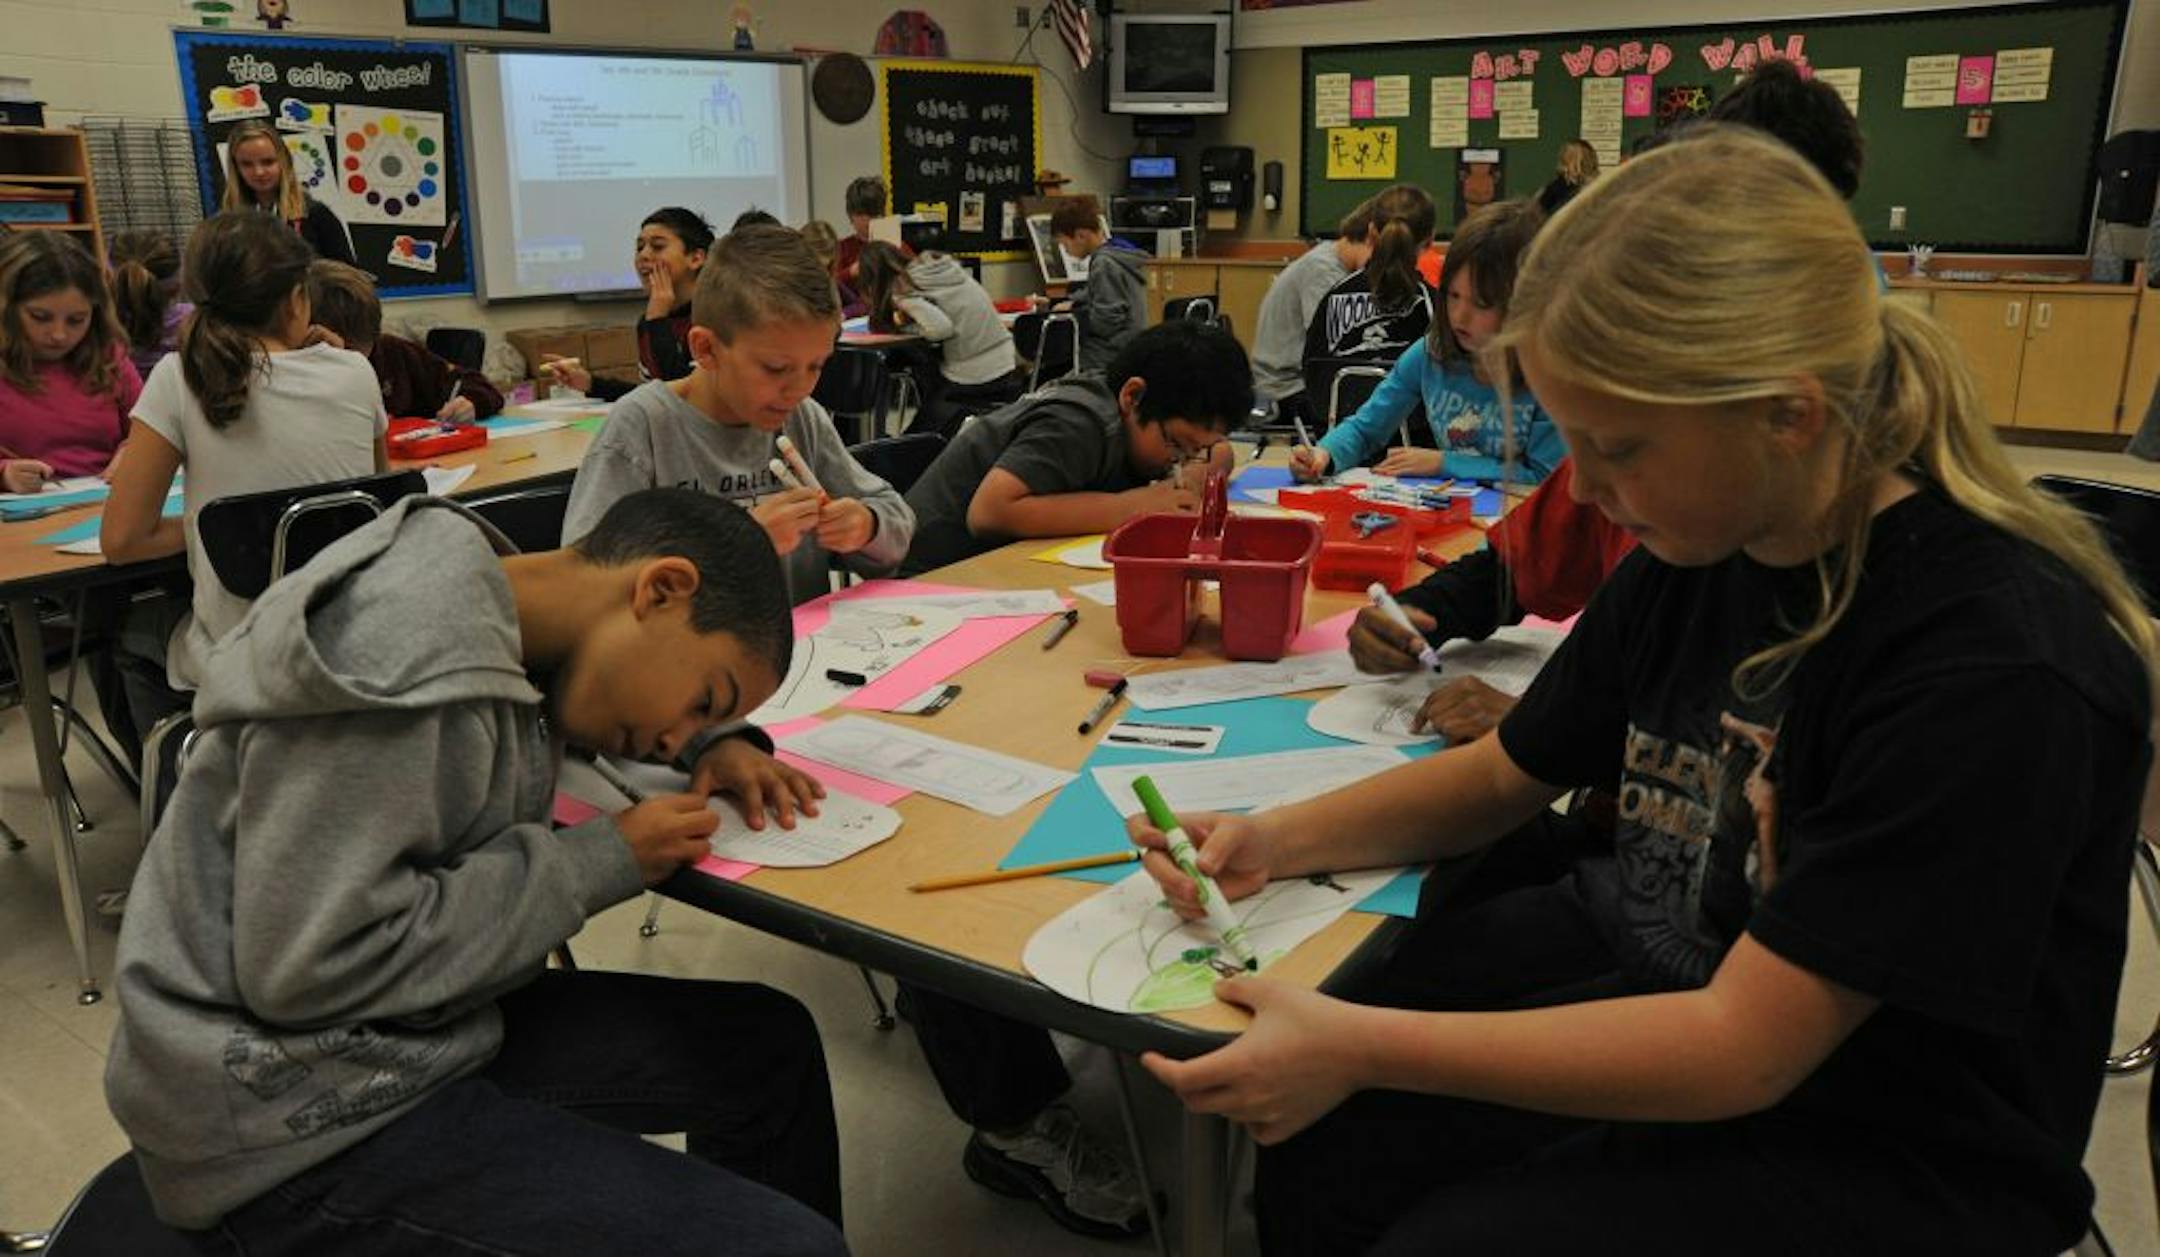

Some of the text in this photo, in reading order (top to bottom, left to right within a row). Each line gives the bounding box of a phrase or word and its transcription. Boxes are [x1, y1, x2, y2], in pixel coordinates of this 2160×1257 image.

[227, 54, 278, 83] the
[287, 63, 353, 90] color
[1471, 49, 1541, 80] ART
[1561, 41, 1672, 77] WORD
[919, 157, 950, 176] art
